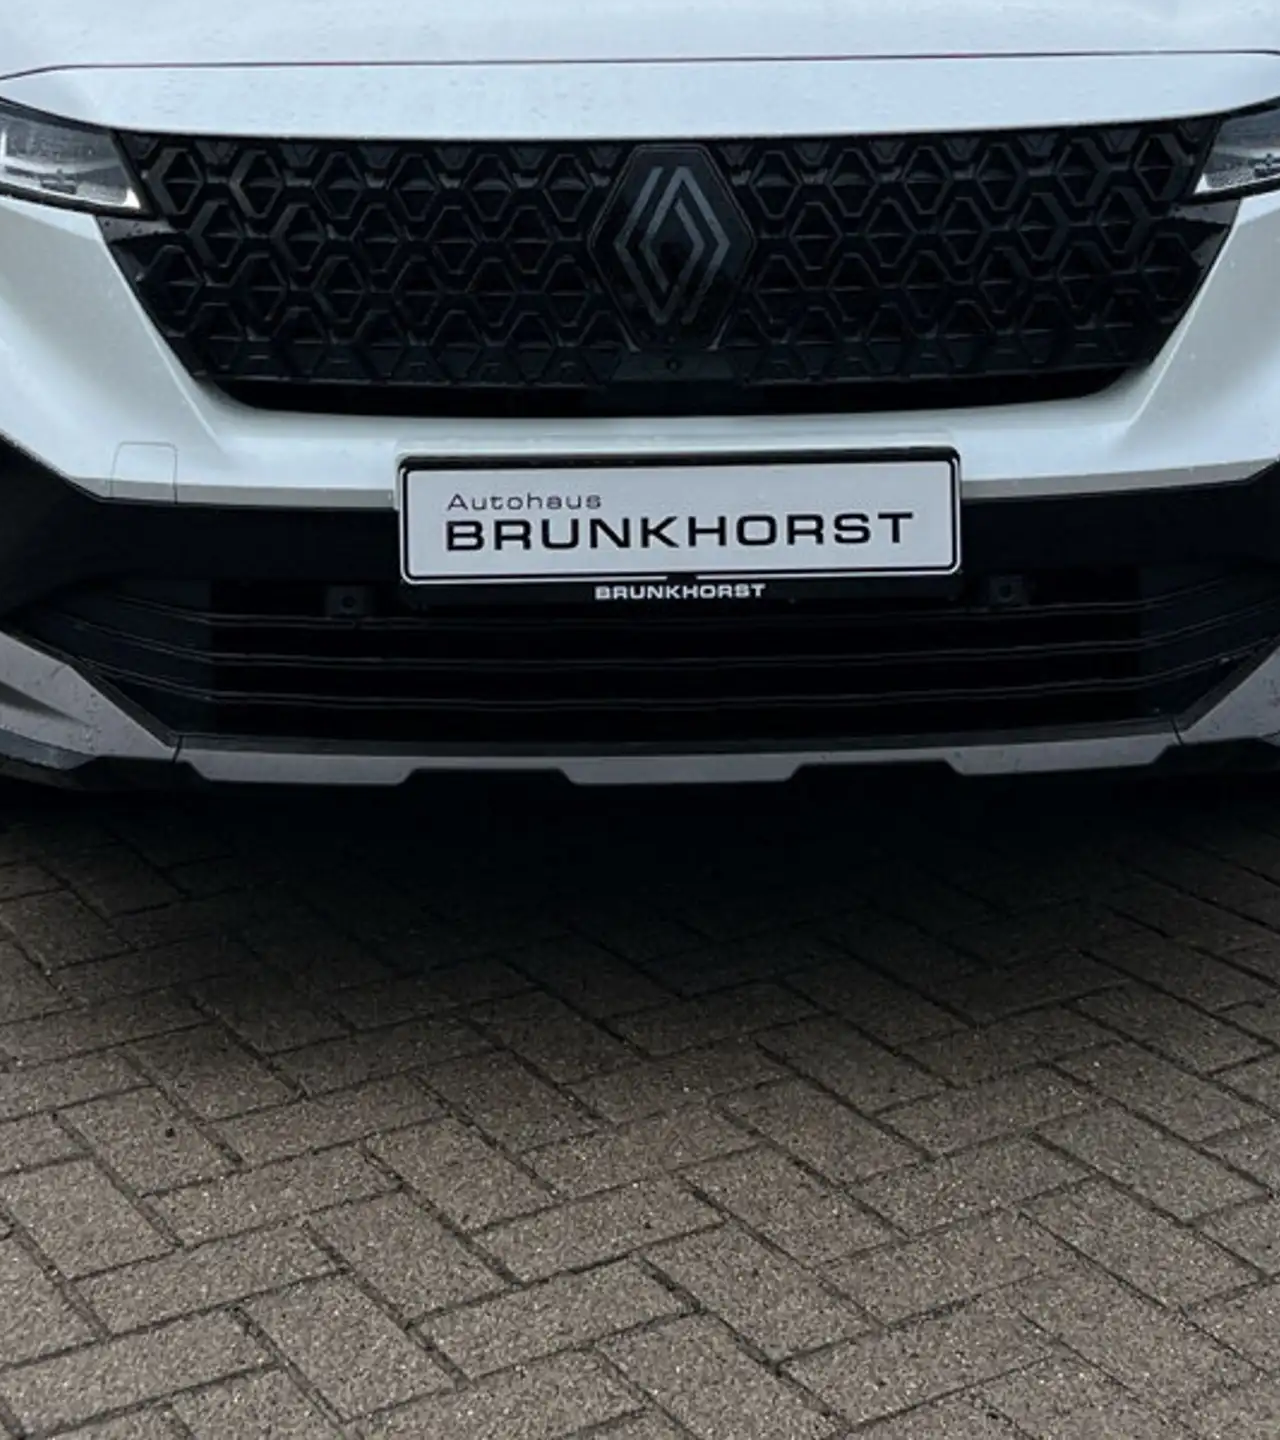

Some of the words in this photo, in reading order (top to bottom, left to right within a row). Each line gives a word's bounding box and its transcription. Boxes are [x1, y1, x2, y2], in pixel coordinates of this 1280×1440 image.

[447, 492, 602, 512] Autohaus
[446, 512, 914, 552] BRUNKHORST
[595, 583, 766, 600] BRUNKHORST
